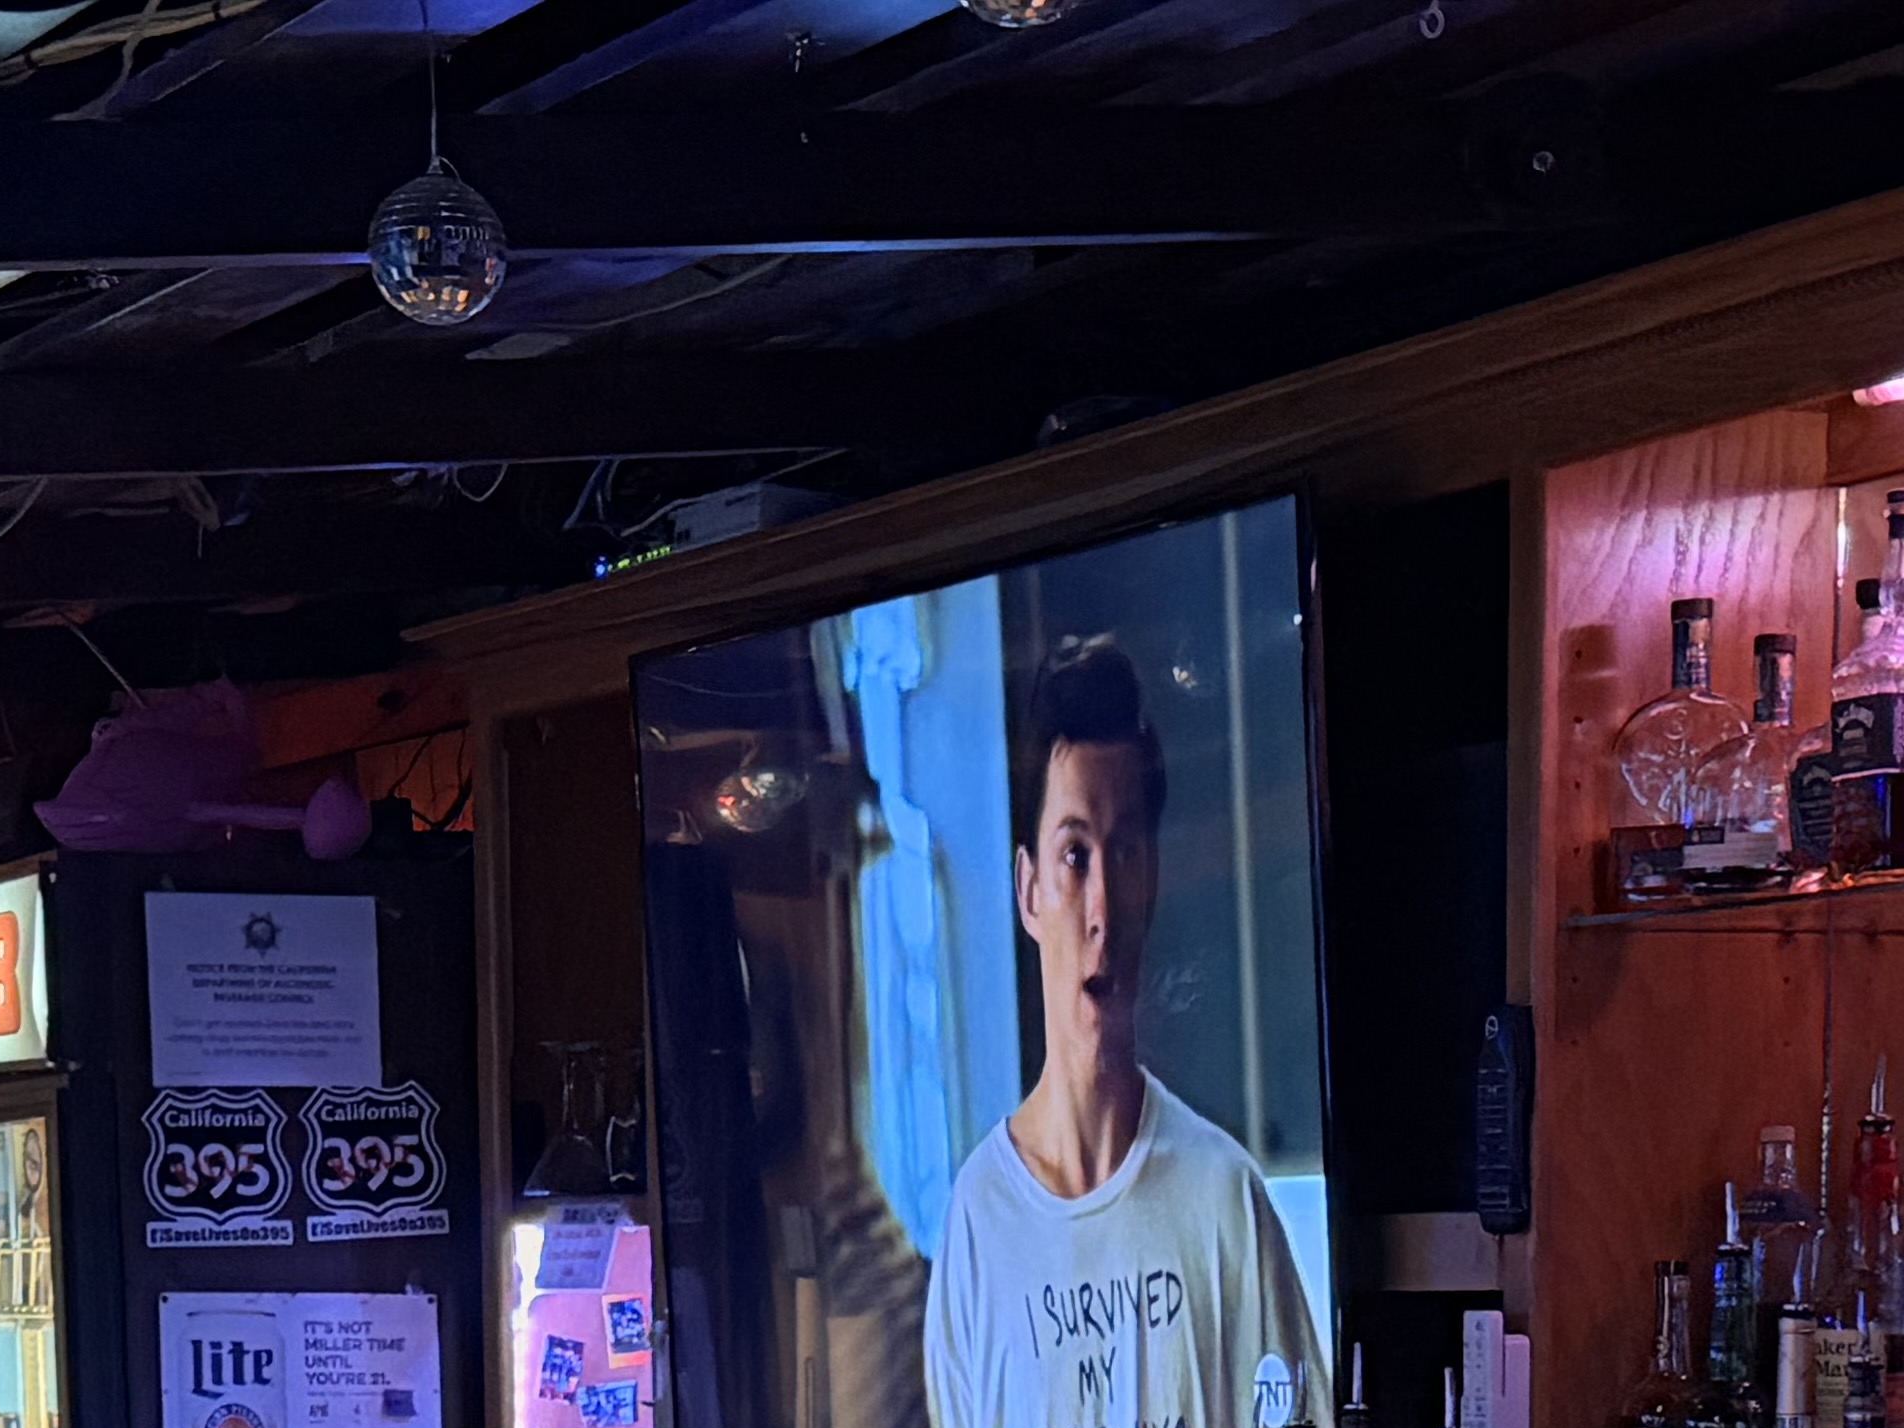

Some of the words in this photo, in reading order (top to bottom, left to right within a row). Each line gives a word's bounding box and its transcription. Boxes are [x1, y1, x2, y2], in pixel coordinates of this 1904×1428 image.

[164, 1108, 266, 1128] California
[320, 1102, 420, 1121] California
[164, 1142, 270, 1199] 395
[322, 1134, 425, 1191] 395
[338, 1320, 373, 1334] NOT
[1025, 1293, 1040, 1358] I
[1043, 1270, 1184, 1348] SURVIVED
[304, 1338, 364, 1352] MILLER
[190, 1339, 274, 1400] Lite
[1078, 1347, 1117, 1406] MY
[1816, 1359, 1848, 1377] Mar
[1253, 1378, 1292, 1409] TNT
